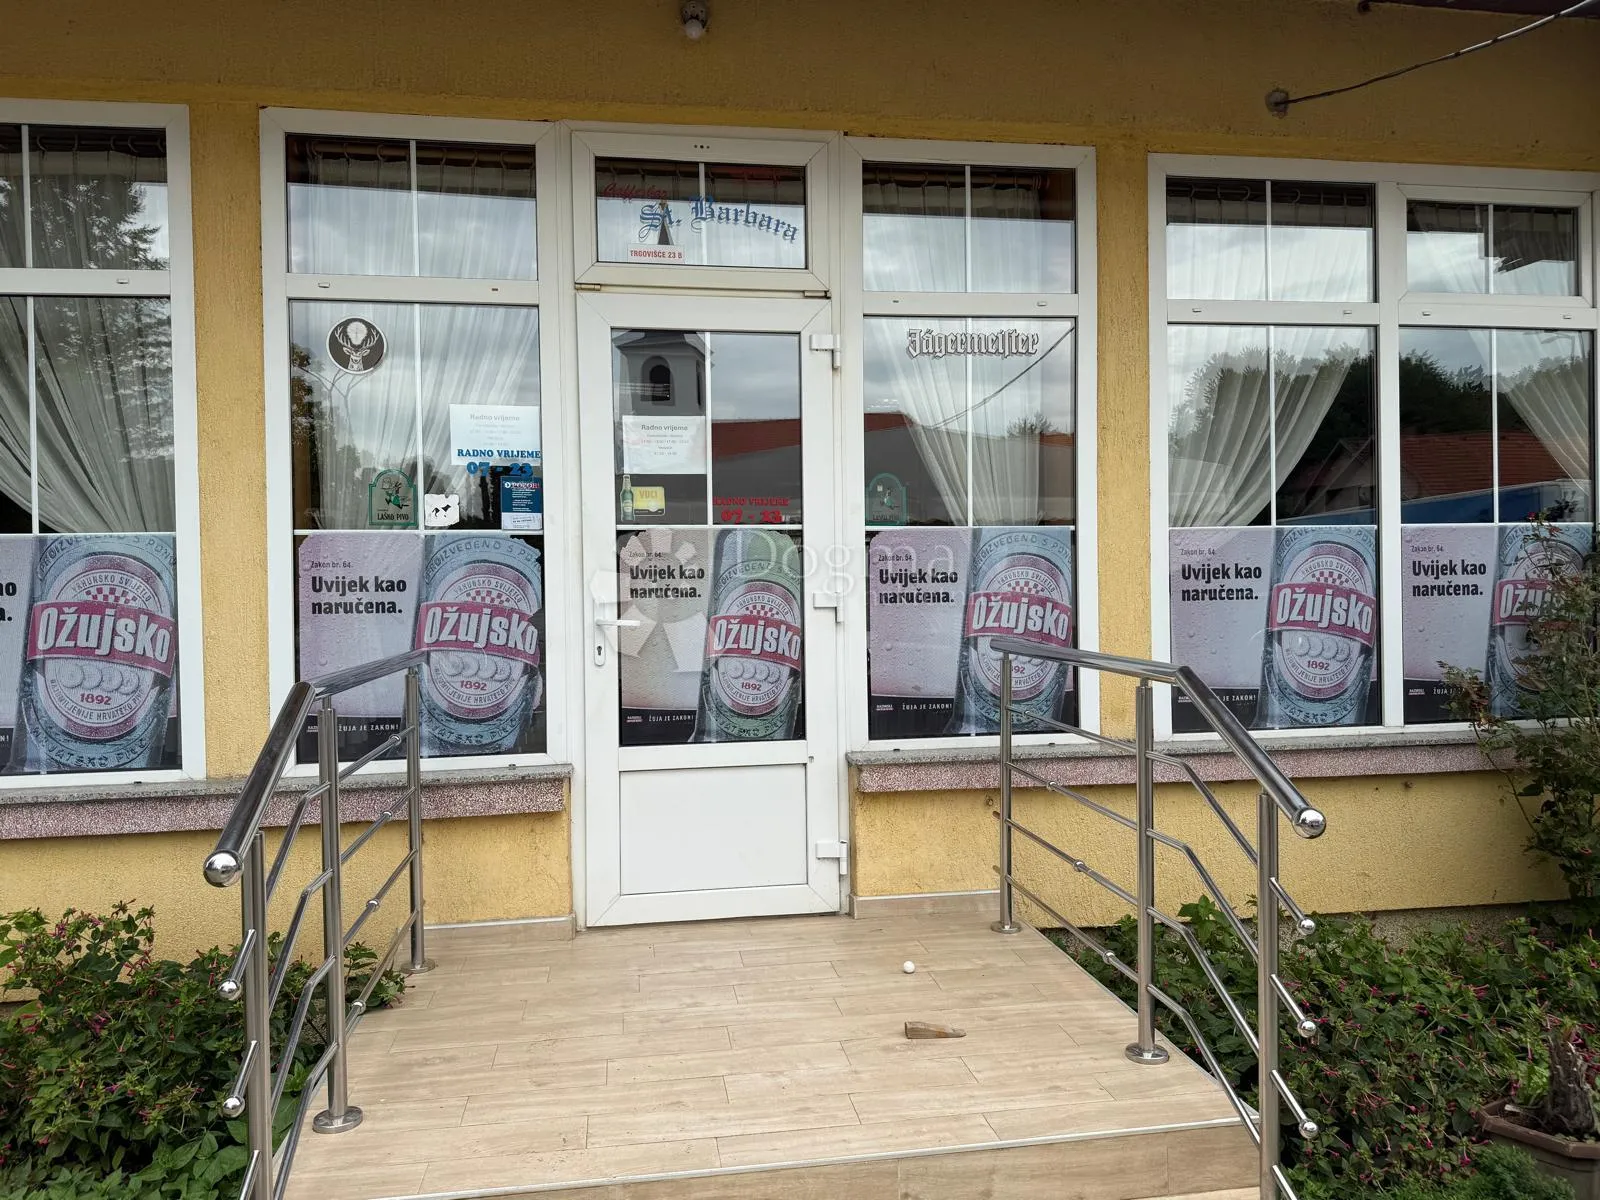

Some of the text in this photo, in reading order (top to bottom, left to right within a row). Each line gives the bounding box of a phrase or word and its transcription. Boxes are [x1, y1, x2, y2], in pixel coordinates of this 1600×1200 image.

[688, 195, 798, 243] Barbara
[664, 424, 688, 432] vrijeme
[457, 448, 541, 459] RADNO VRIJEME
[467, 461, 491, 477] 07
[510, 462, 533, 477] 23
[377, 512, 395, 520] LAŠKO
[721, 508, 743, 523] 07
[629, 565, 705, 583] Uvijek kao
[1181, 563, 1262, 584] Uvijek kao
[1412, 559, 1487, 579] Uvijek kao
[879, 568, 958, 587] Uvijek kao
[311, 576, 407, 596] Uvijek kao
[629, 584, 702, 598] naručena.
[1181, 584, 1259, 601] naručena.
[1412, 581, 1483, 596] naručena.
[879, 588, 954, 604] naručena.
[311, 597, 402, 614] naručena.
[1276, 587, 1372, 634] Ožujsko
[972, 596, 1069, 641] Ožujsko
[37, 607, 171, 663] Ožujsko
[424, 606, 538, 655] Ožujsko
[713, 618, 801, 661] Ožujsko
[1307, 660, 1330, 671] 1892
[460, 680, 488, 691] 1892
[741, 682, 762, 691] 1892
[1433, 687, 1448, 695] ŽUJA
[80, 692, 112, 705] 1892
[902, 702, 917, 710] ŽUJA
[338, 724, 357, 732] ŽUJA
